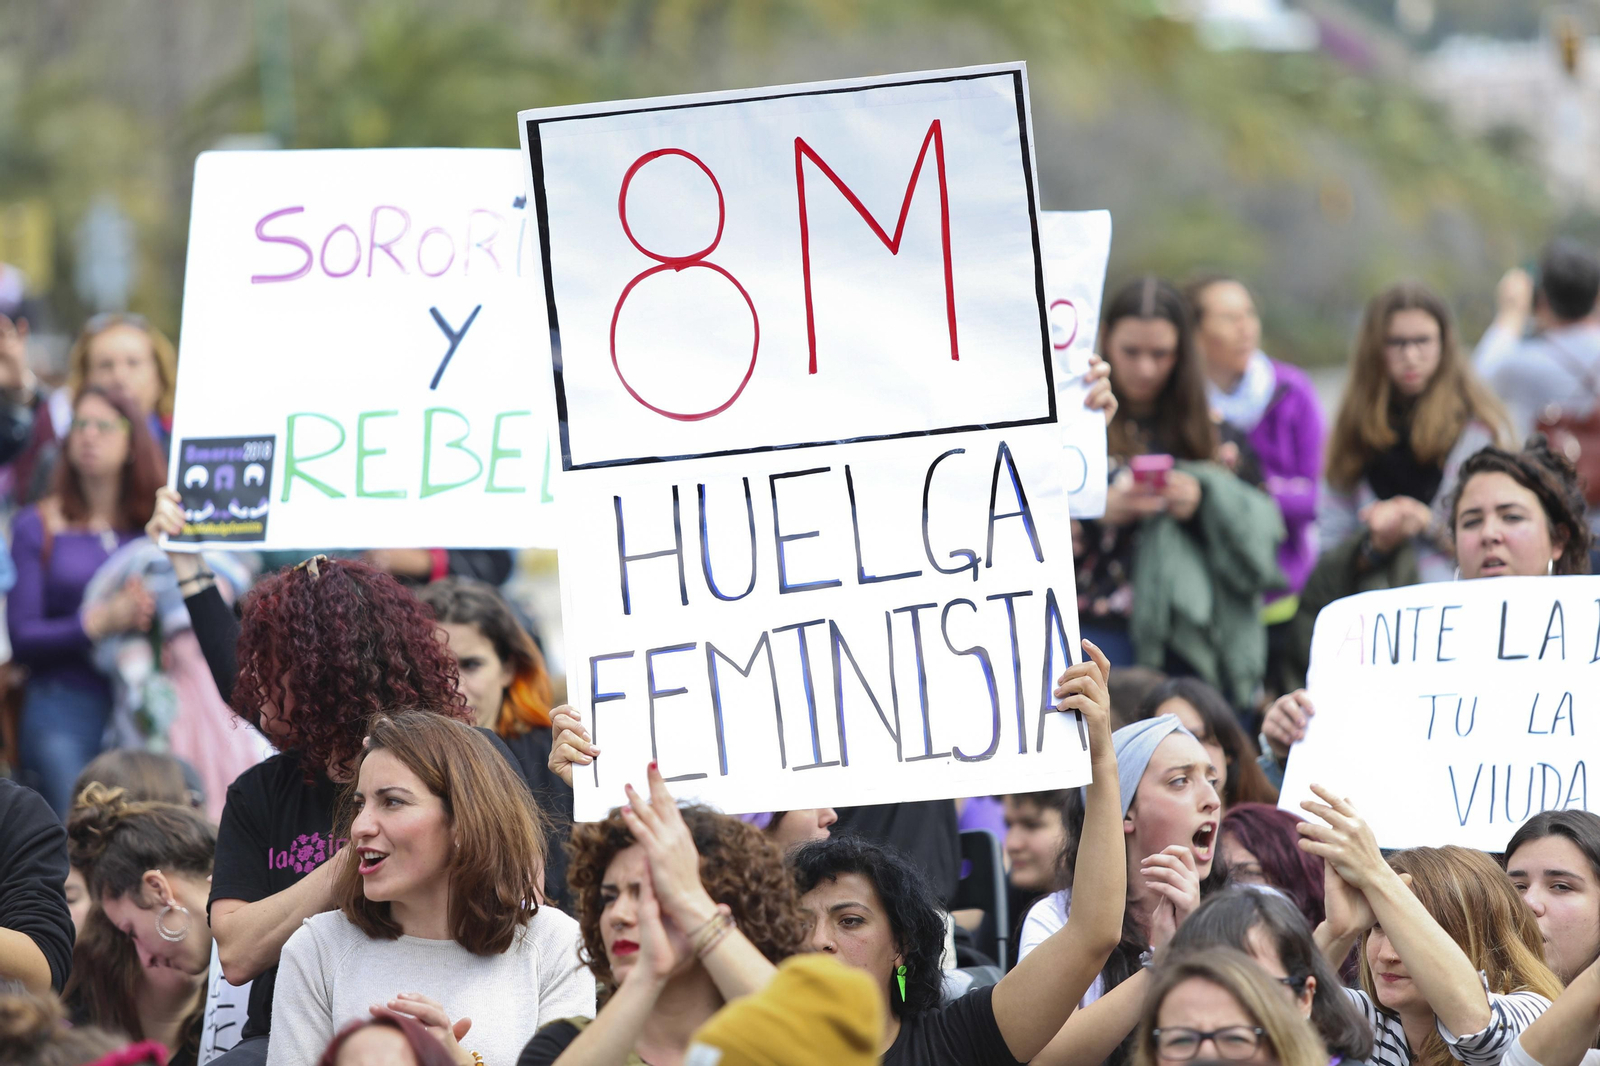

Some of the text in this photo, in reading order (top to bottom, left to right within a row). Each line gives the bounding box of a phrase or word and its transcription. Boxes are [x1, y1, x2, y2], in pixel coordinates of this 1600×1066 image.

[609, 119, 966, 422] 8M
[429, 304, 483, 391] Y
[613, 440, 1044, 616] HUELGA
[1337, 604, 1463, 665] ANTE
[1497, 599, 1566, 660] LA
[588, 587, 1088, 788] FEMINISTA
[1418, 691, 1575, 740] TU LA
[1448, 759, 1588, 827] VIUDA
